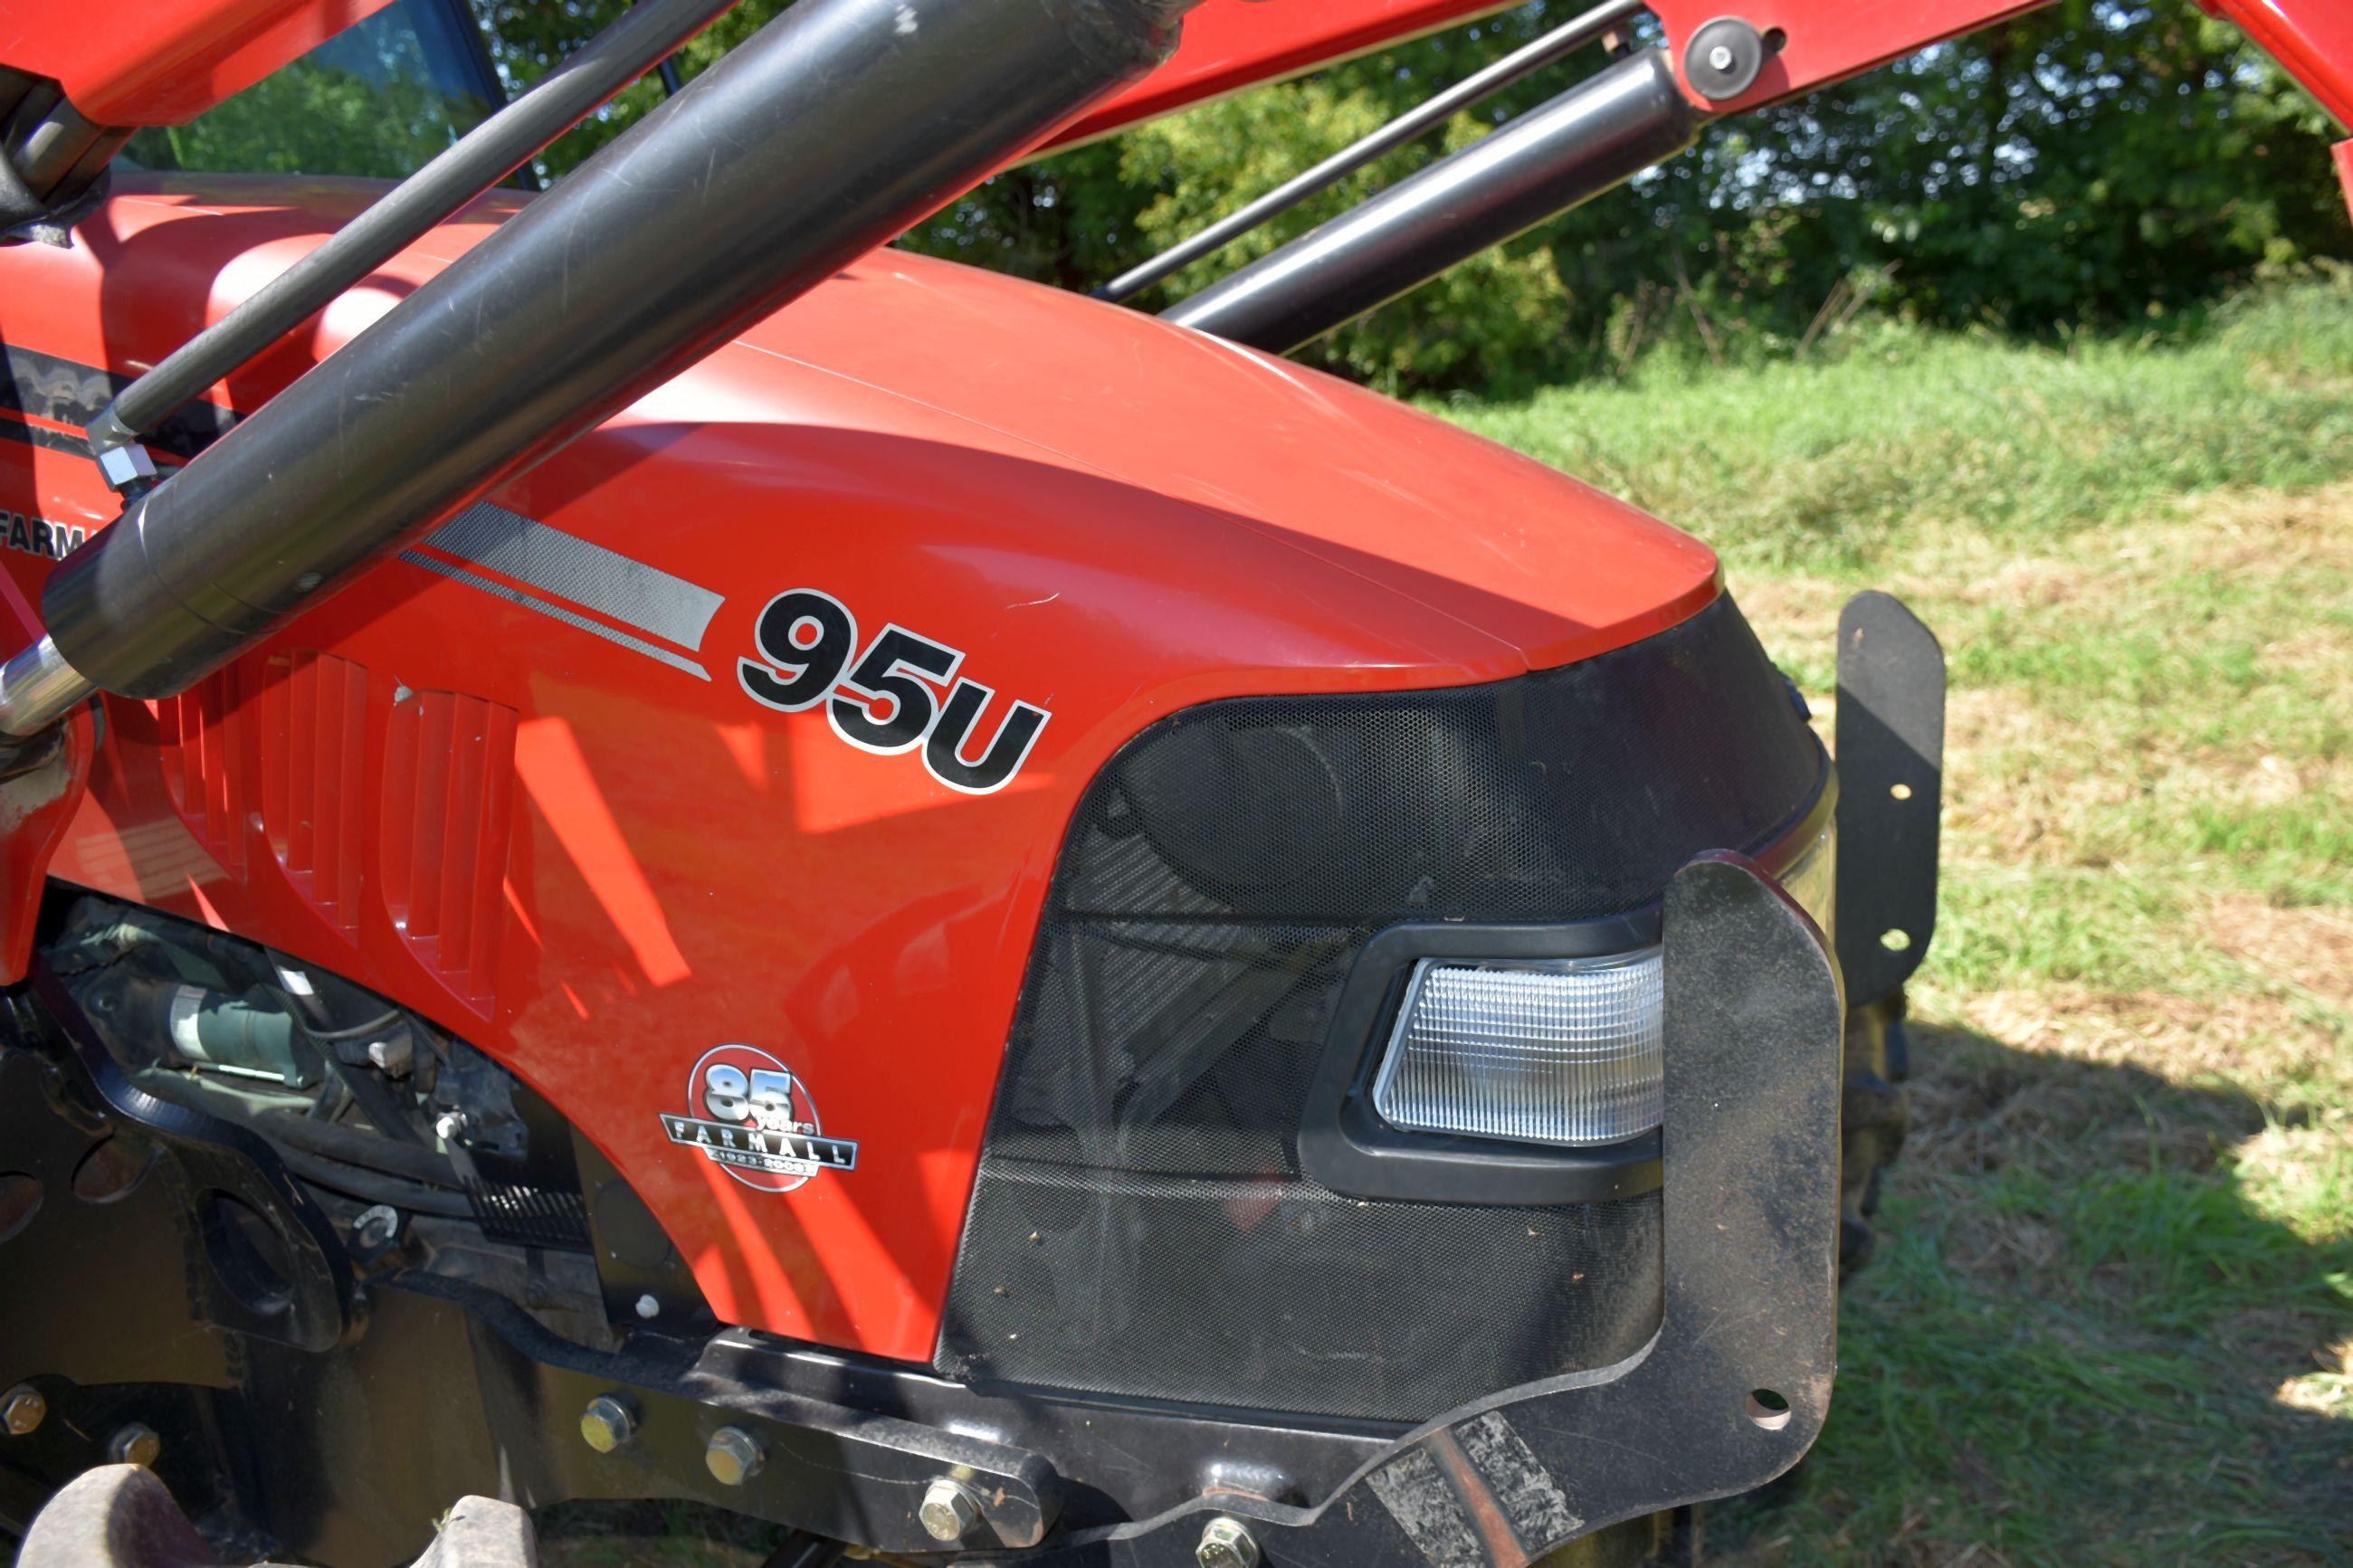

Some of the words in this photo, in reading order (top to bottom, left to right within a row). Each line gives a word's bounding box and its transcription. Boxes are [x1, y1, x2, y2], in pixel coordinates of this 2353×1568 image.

[0, 508, 97, 561] FARM
[737, 588, 1053, 795] 95U
[703, 1062, 795, 1123] 85
[672, 1121, 847, 1165] FARMALL
[755, 1114, 815, 1136] years
